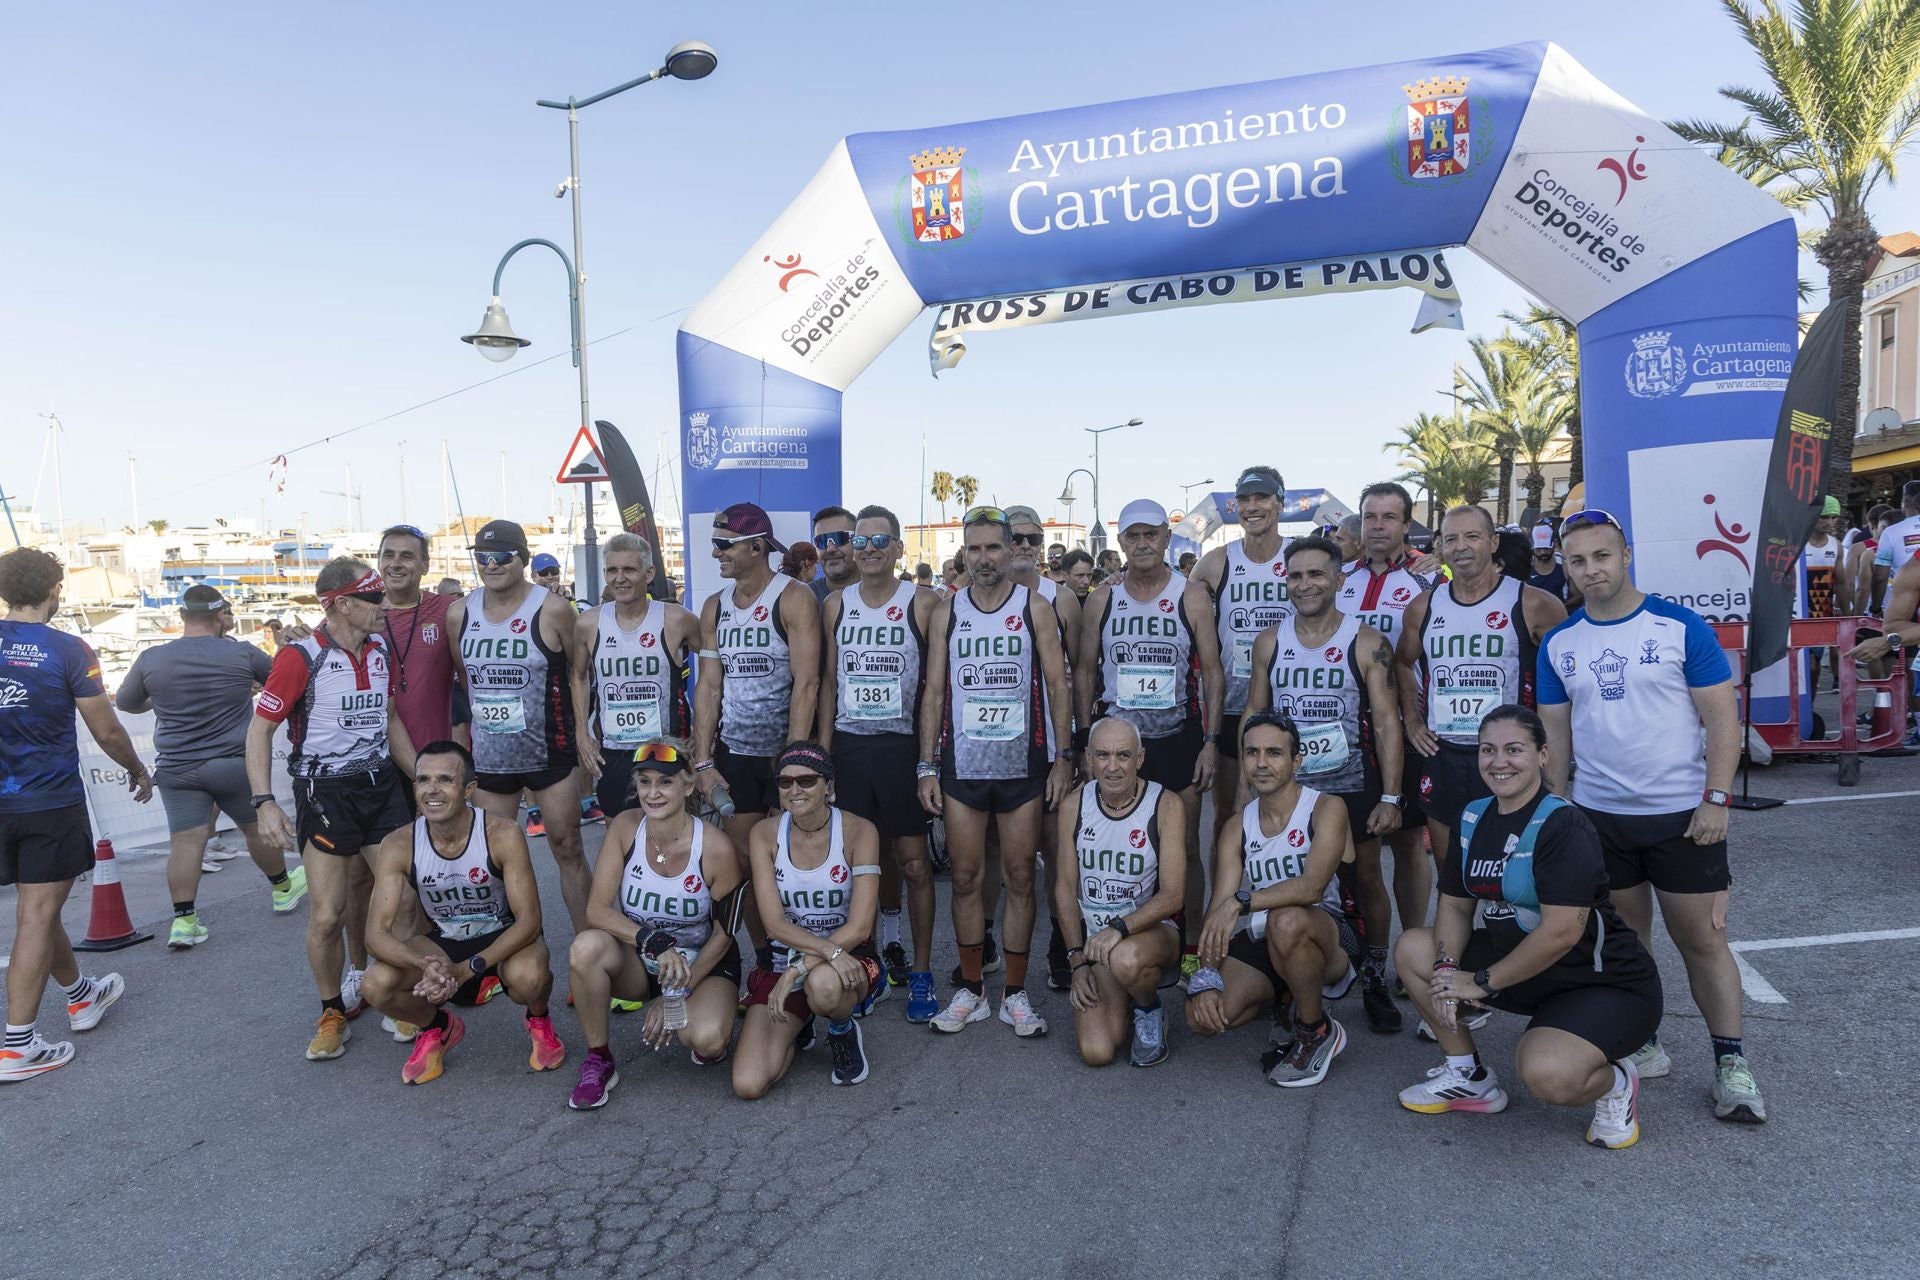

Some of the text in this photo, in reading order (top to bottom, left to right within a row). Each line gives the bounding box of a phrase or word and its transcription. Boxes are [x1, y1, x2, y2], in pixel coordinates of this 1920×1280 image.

[1008, 102, 1347, 178] Ayuntamiento
[1009, 154, 1348, 235] Cartagena
[1533, 169, 1645, 256] Concejalía de
[1514, 181, 1631, 272] Deportes
[846, 254, 866, 274] de
[1064, 286, 1110, 313] DE
[1126, 274, 1236, 305] CABO
[1254, 267, 1303, 293] DE
[1322, 252, 1454, 289] PALOS
[790, 265, 880, 357] Deportes
[1692, 339, 1791, 358] Ayuntamiento
[1692, 358, 1792, 377] Cartagena
[721, 424, 808, 439] Ayuntamiento
[721, 438, 808, 457] Cartagena
[737, 458, 807, 468] www.cartagena.es
[1230, 582, 1290, 603] UNED
[1112, 616, 1178, 638] UNED
[717, 627, 770, 649] UNED
[841, 626, 905, 646] UNED
[2, 650, 48, 659] FORTALEZAS
[12, 643, 39, 653] RUTA
[462, 638, 528, 659] UNED
[957, 635, 1022, 659] UNED
[1148, 647, 1173, 655] CABEZO
[1430, 634, 1504, 659] UNED
[600, 655, 660, 677] UNED
[876, 656, 900, 664] CABEZO
[1138, 654, 1172, 663] VENTURA
[738, 665, 769, 673] VENTURA
[865, 664, 899, 673] VENTURA
[994, 667, 1018, 675] CABEZO
[1470, 670, 1498, 678] CABEZO
[488, 676, 524, 685] VENTURA
[985, 676, 1018, 685] VENTURA
[1137, 677, 1158, 692] 14
[1275, 667, 1345, 689] UNED
[1459, 679, 1497, 687] VENTURA
[625, 693, 656, 701] VENTURA
[854, 687, 891, 703] 1381
[1600, 686, 1625, 697] 2025
[341, 692, 383, 711] UNED
[1314, 700, 1338, 708] CABEZO
[1449, 698, 1484, 715] 107
[482, 706, 510, 721] 328
[616, 711, 646, 727] 606
[978, 707, 1010, 723] 277
[1302, 709, 1338, 718] VENTURA
[1082, 848, 1145, 876] UNED
[426, 885, 491, 904] UNED
[626, 885, 699, 918] UNED
[460, 923, 471, 935] 7
[816, 917, 840, 926] CABEZO
